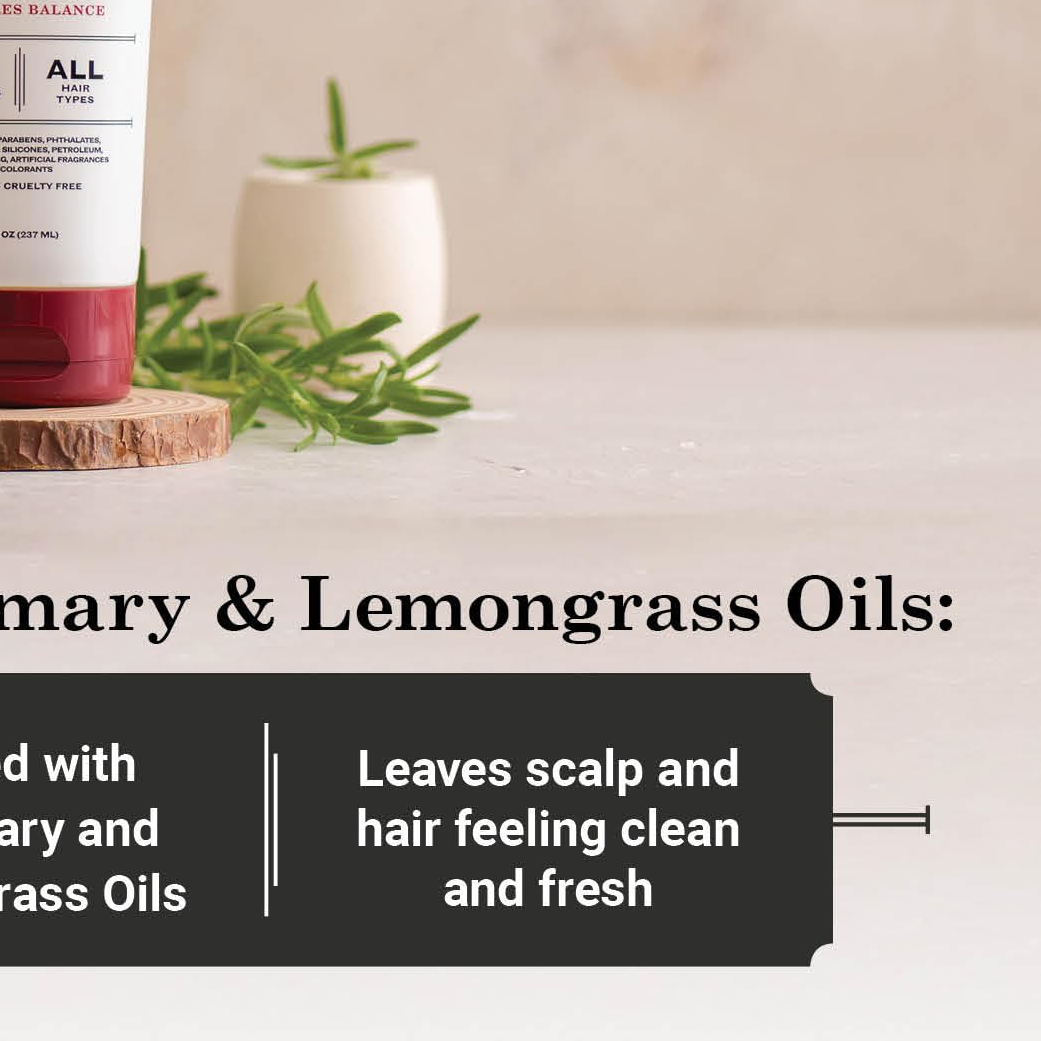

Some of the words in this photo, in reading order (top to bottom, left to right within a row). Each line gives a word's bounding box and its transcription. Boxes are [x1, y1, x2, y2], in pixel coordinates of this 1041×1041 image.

[29, 4, 106, 16] BALANCE
[46, 59, 104, 80] ALL
[61, 84, 91, 93] HAIR
[56, 95, 95, 105] TYPES
[46, 137, 102, 145] PHTHALATES,
[2, 146, 51, 154] SILICONES,
[3, 182, 53, 190] CRUELTY
[55, 182, 82, 190] FREE
[16, 230, 38, 240] (237
[40, 230, 59, 240] ML)
